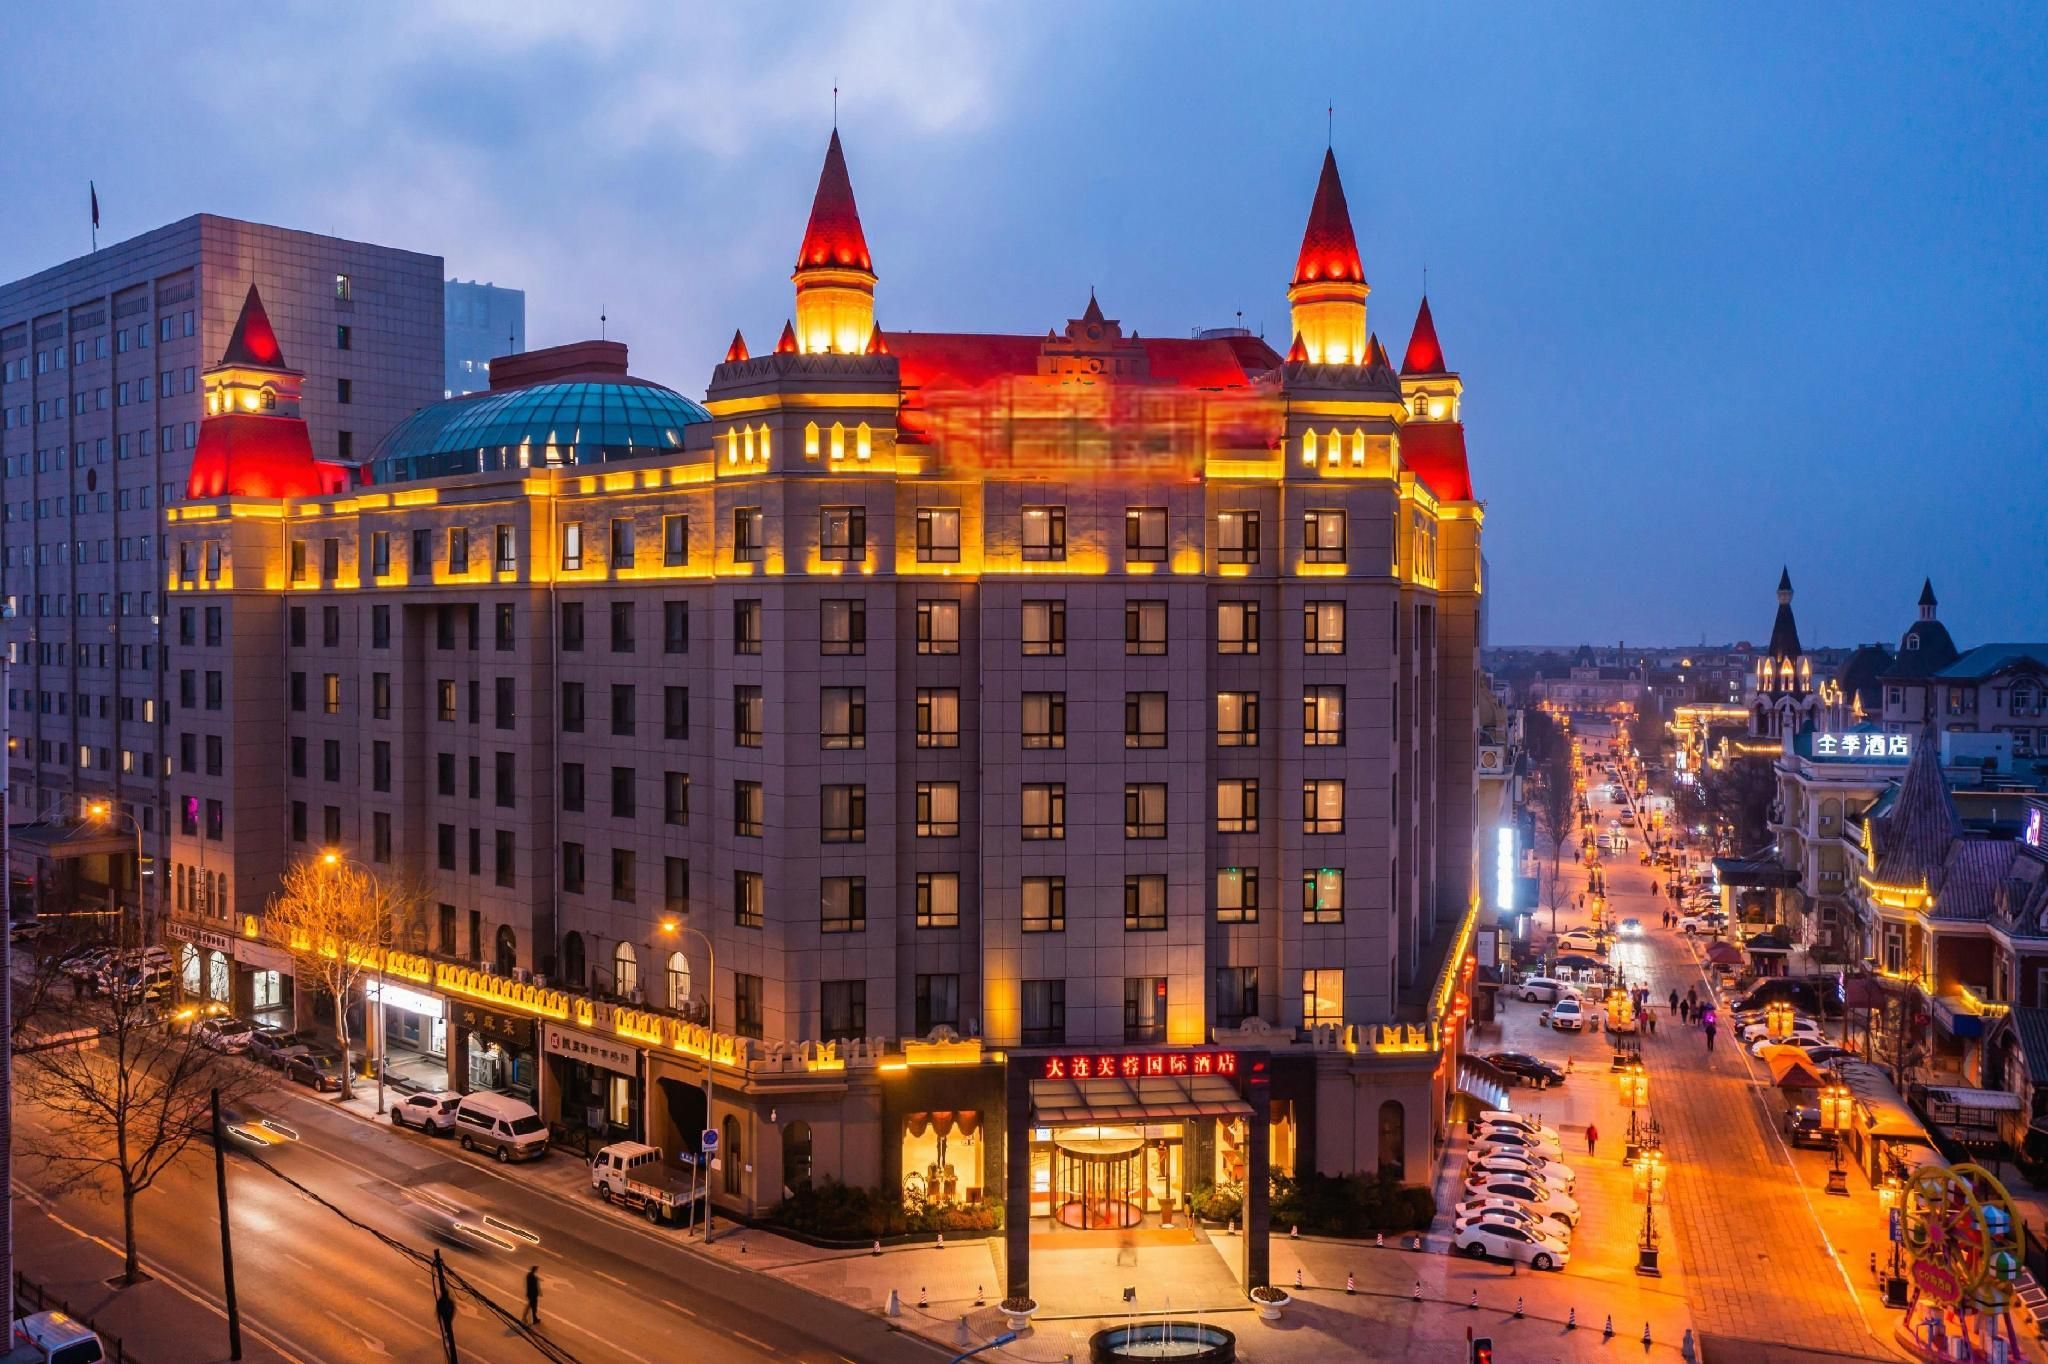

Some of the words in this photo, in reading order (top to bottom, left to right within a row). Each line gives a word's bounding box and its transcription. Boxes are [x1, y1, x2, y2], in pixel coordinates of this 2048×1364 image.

[1817, 733, 1908, 756] 全季酒店
[1045, 1054, 1236, 1079] 大连芙蓉国际酒店
